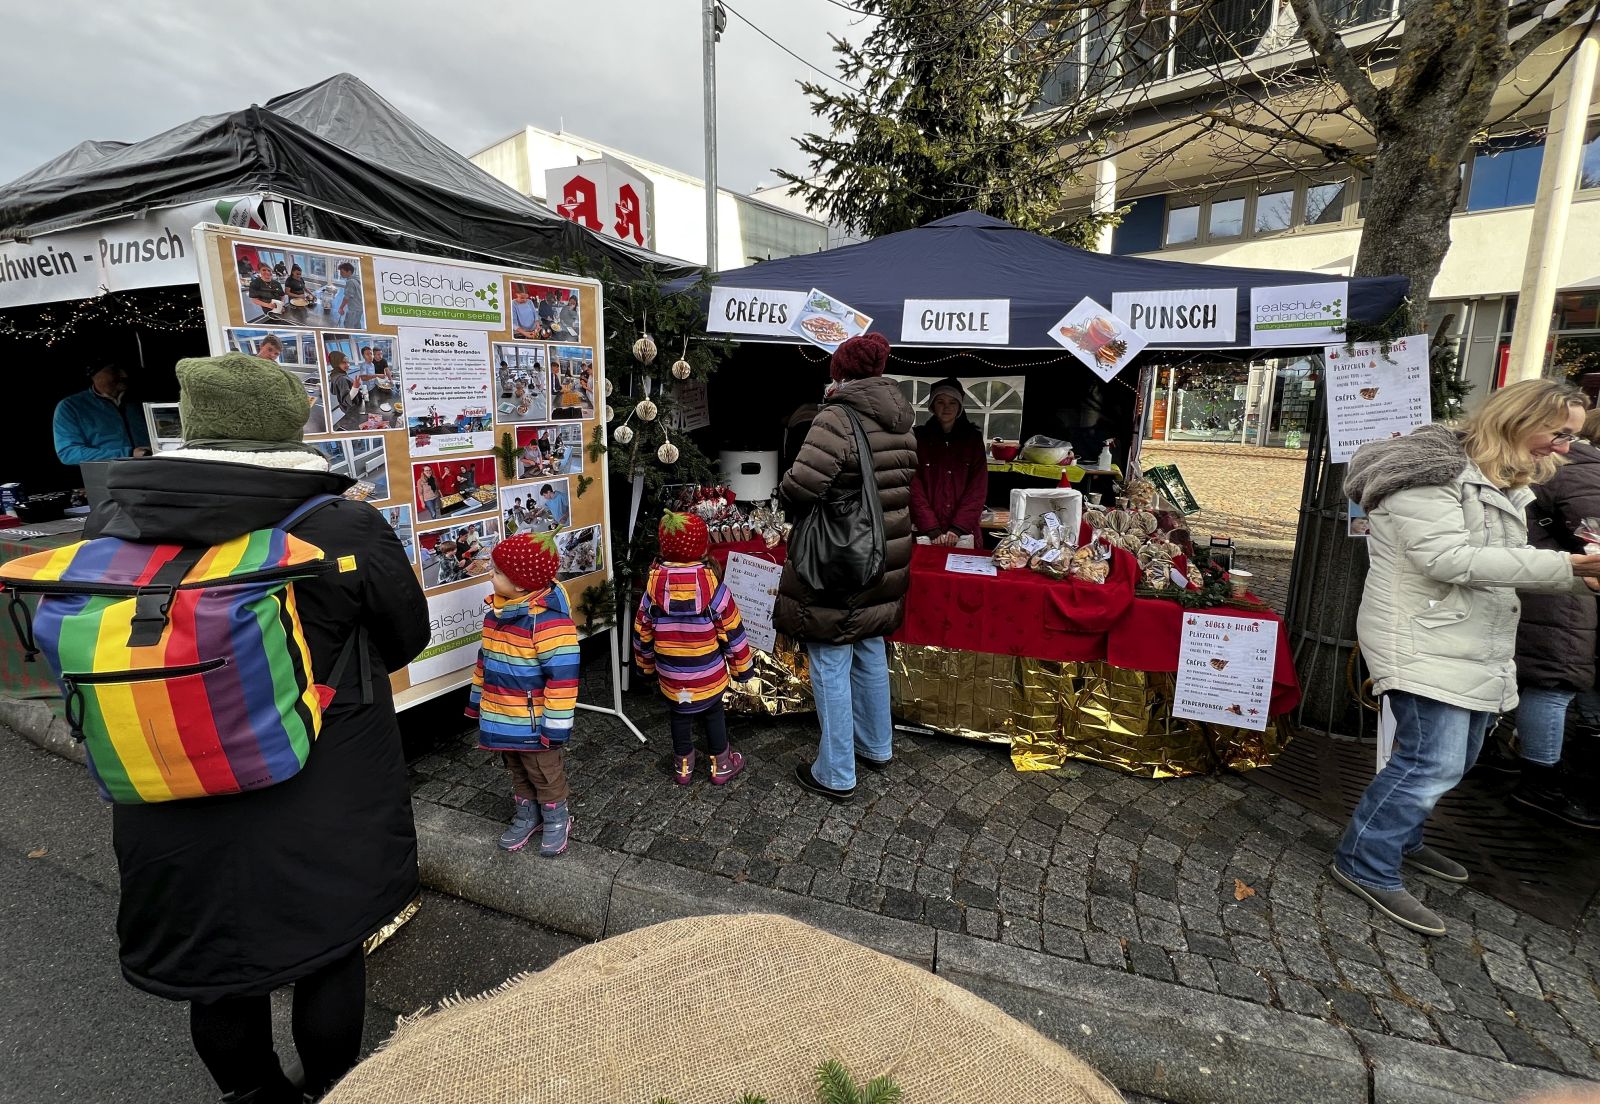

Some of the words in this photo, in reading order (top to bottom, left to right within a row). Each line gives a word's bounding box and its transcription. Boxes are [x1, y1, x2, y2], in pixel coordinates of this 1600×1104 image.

[98, 227, 184, 268] Punsch
[380, 272, 474, 292] realschule
[382, 286, 476, 308] bonlanden
[1256, 300, 1322, 312] realschule
[383, 304, 465, 319] bildungszentrum
[725, 296, 788, 324] CRÊPES
[920, 309, 990, 332] GUTSLE
[1130, 303, 1217, 330] PUNSCH
[1256, 311, 1322, 322] bonlanden
[424, 339, 454, 347] Klasse
[430, 603, 491, 631] alschule
[430, 619, 484, 646] nlande
[1186, 659, 1206, 667] CRÊPES
